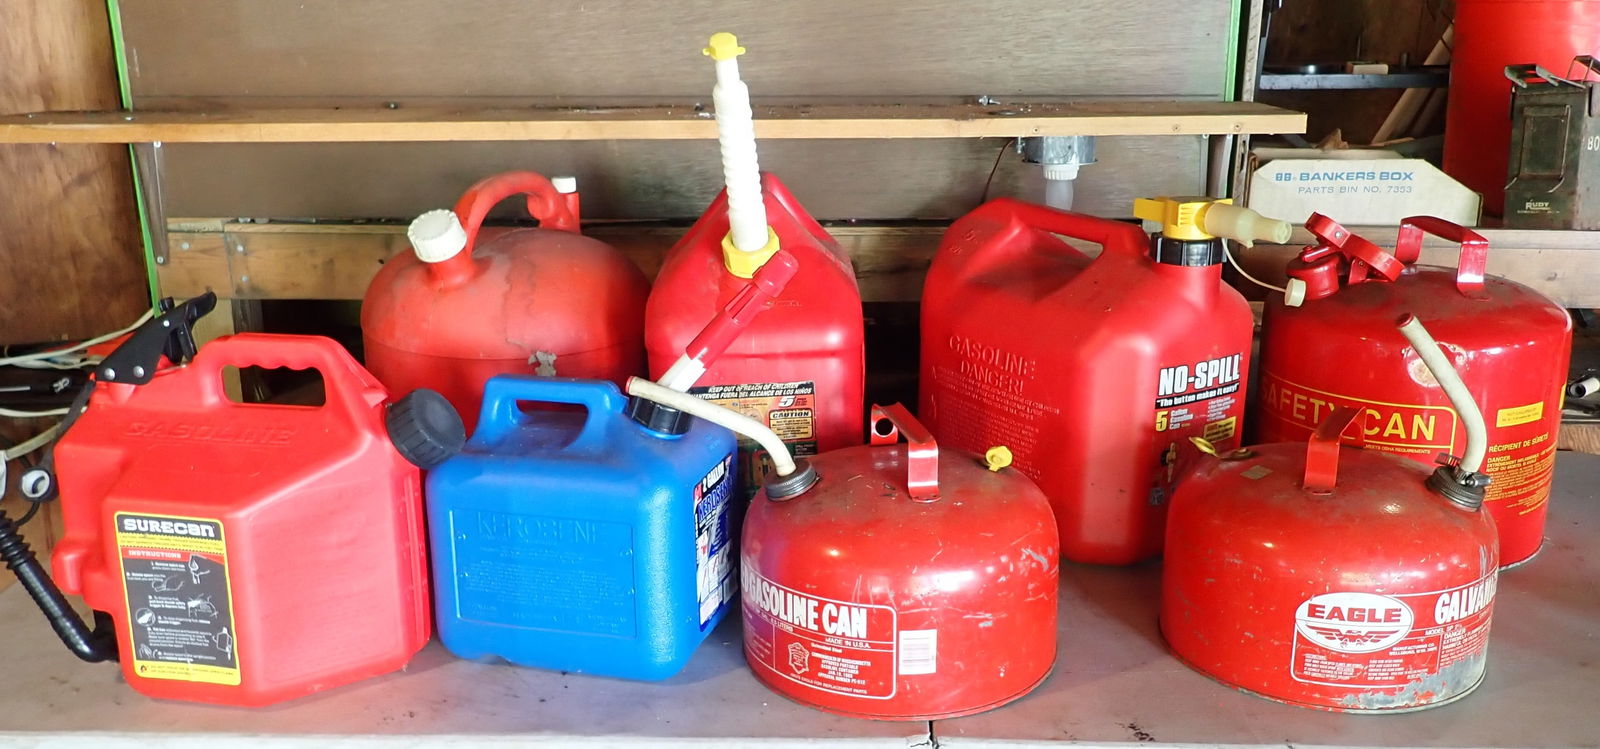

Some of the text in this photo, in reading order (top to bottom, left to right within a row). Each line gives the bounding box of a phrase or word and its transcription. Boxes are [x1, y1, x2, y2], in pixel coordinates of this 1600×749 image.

[1300, 172, 1376, 181] BANKERS
[1379, 171, 1414, 181] BOX
[1298, 186, 1334, 194] PARTS
[949, 336, 1037, 380] GASOLINE
[961, 361, 1024, 396] DANGER!
[1158, 354, 1240, 397] NO-SPILL
[709, 385, 724, 393] KEEP
[779, 396, 796, 407] 5
[1156, 399, 1174, 407] "The
[1174, 395, 1196, 405] button
[1197, 391, 1216, 400] makes
[1217, 388, 1223, 396] it
[773, 411, 809, 419] CAUTION
[1261, 383, 1336, 424] SAFET
[1364, 409, 1436, 441] CAN
[1156, 410, 1169, 432] 5
[1488, 441, 1522, 453] RÉCIPIENT
[1487, 455, 1511, 464] DANGER
[128, 550, 182, 558] INSTRUCTIONS
[750, 573, 819, 631] GASOLINE
[823, 603, 868, 639] CAN
[1307, 603, 1402, 623] EAGLE
[1425, 628, 1444, 636] MODEL
[825, 638, 844, 647] MADE
